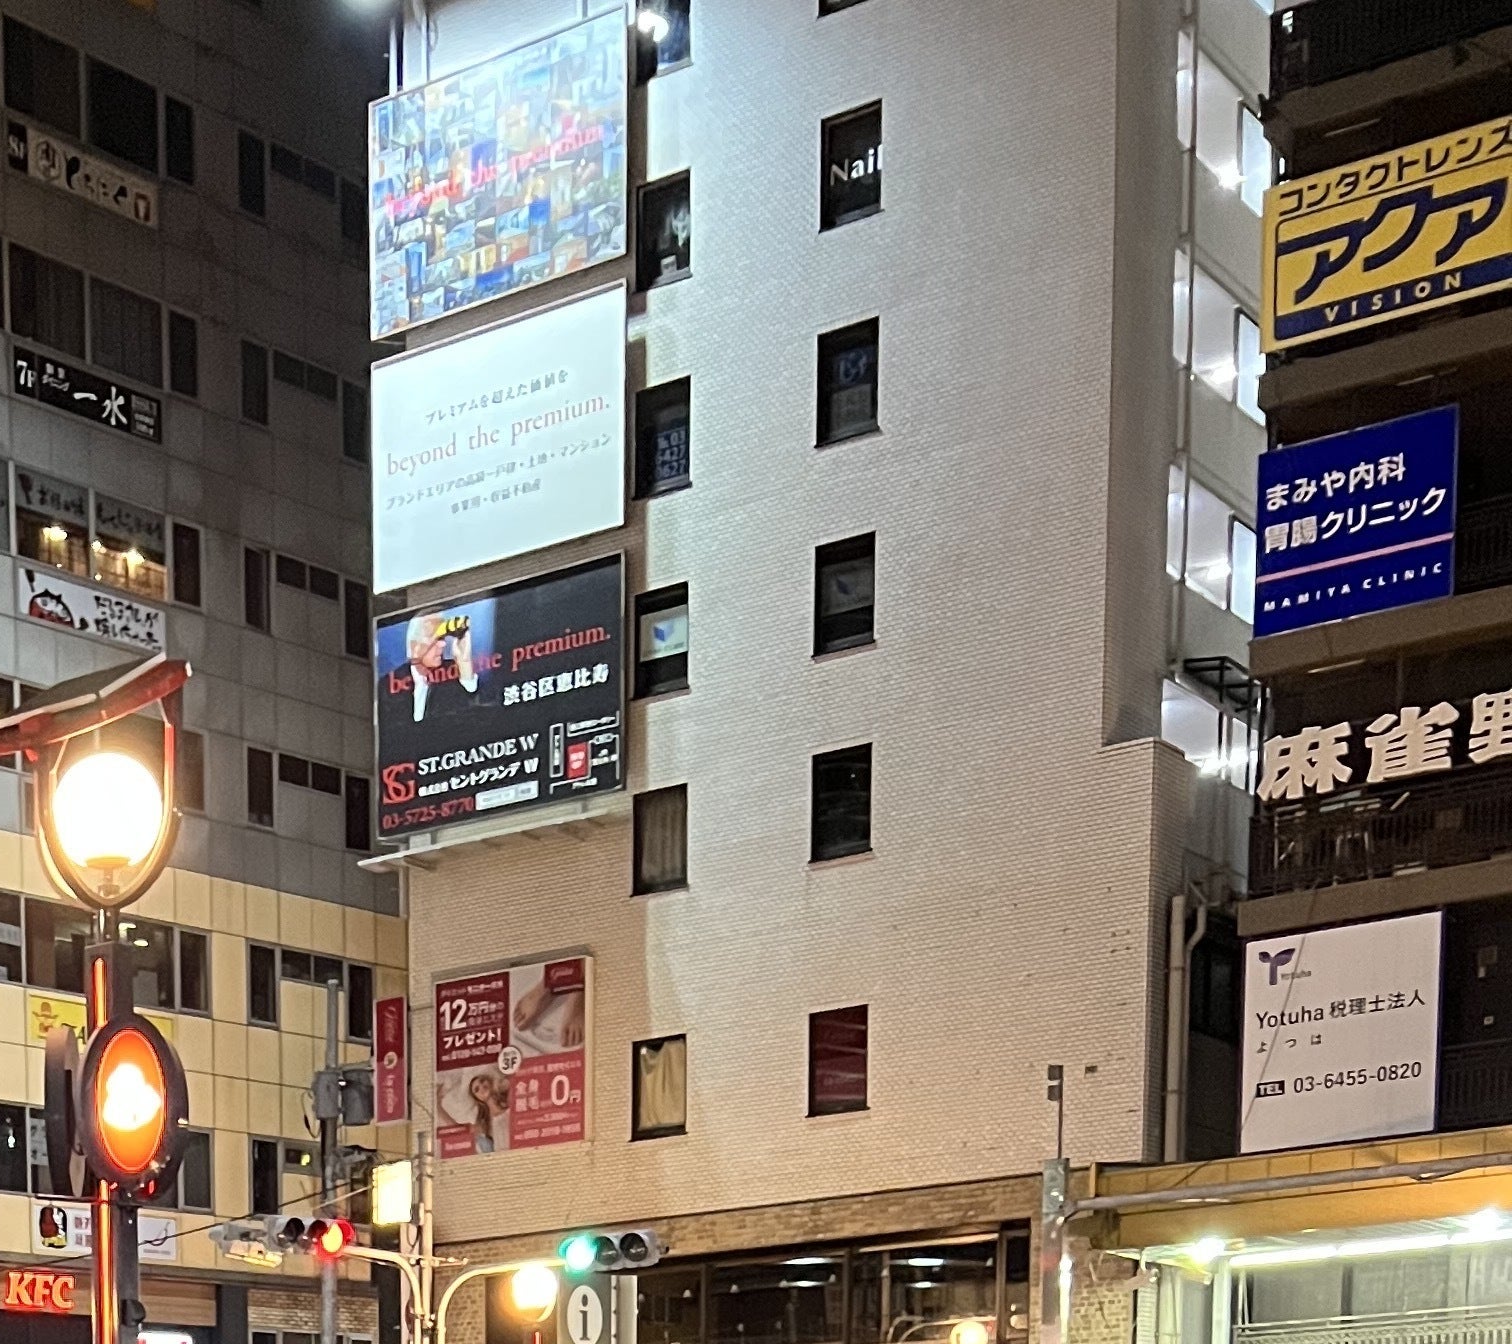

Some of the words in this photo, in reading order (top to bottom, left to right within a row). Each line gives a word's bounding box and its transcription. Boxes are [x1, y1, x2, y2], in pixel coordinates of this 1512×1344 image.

[1277, 177, 1509, 305] アクア
[1325, 272, 1462, 323] VISION
[17, 360, 36, 388] 7F
[387, 432, 457, 479] beyond
[468, 424, 500, 451] the
[511, 395, 610, 446] premium.
[1265, 452, 1406, 511] まみや内科
[1265, 487, 1446, 553] 胃腸クリニック
[1263, 584, 1351, 612] MAMIYA
[1362, 562, 1443, 590] CLINIC
[511, 625, 611, 671] premium.
[418, 738, 517, 776] ST.GRANDE
[519, 732, 539, 751] W
[439, 998, 467, 1031] 12
[1255, 1006, 1324, 1029] Yotuha
[1330, 989, 1426, 1018] 税理士法人
[1293, 1061, 1422, 1093] 03-6455-0820
[4, 1270, 76, 1310] KFC
